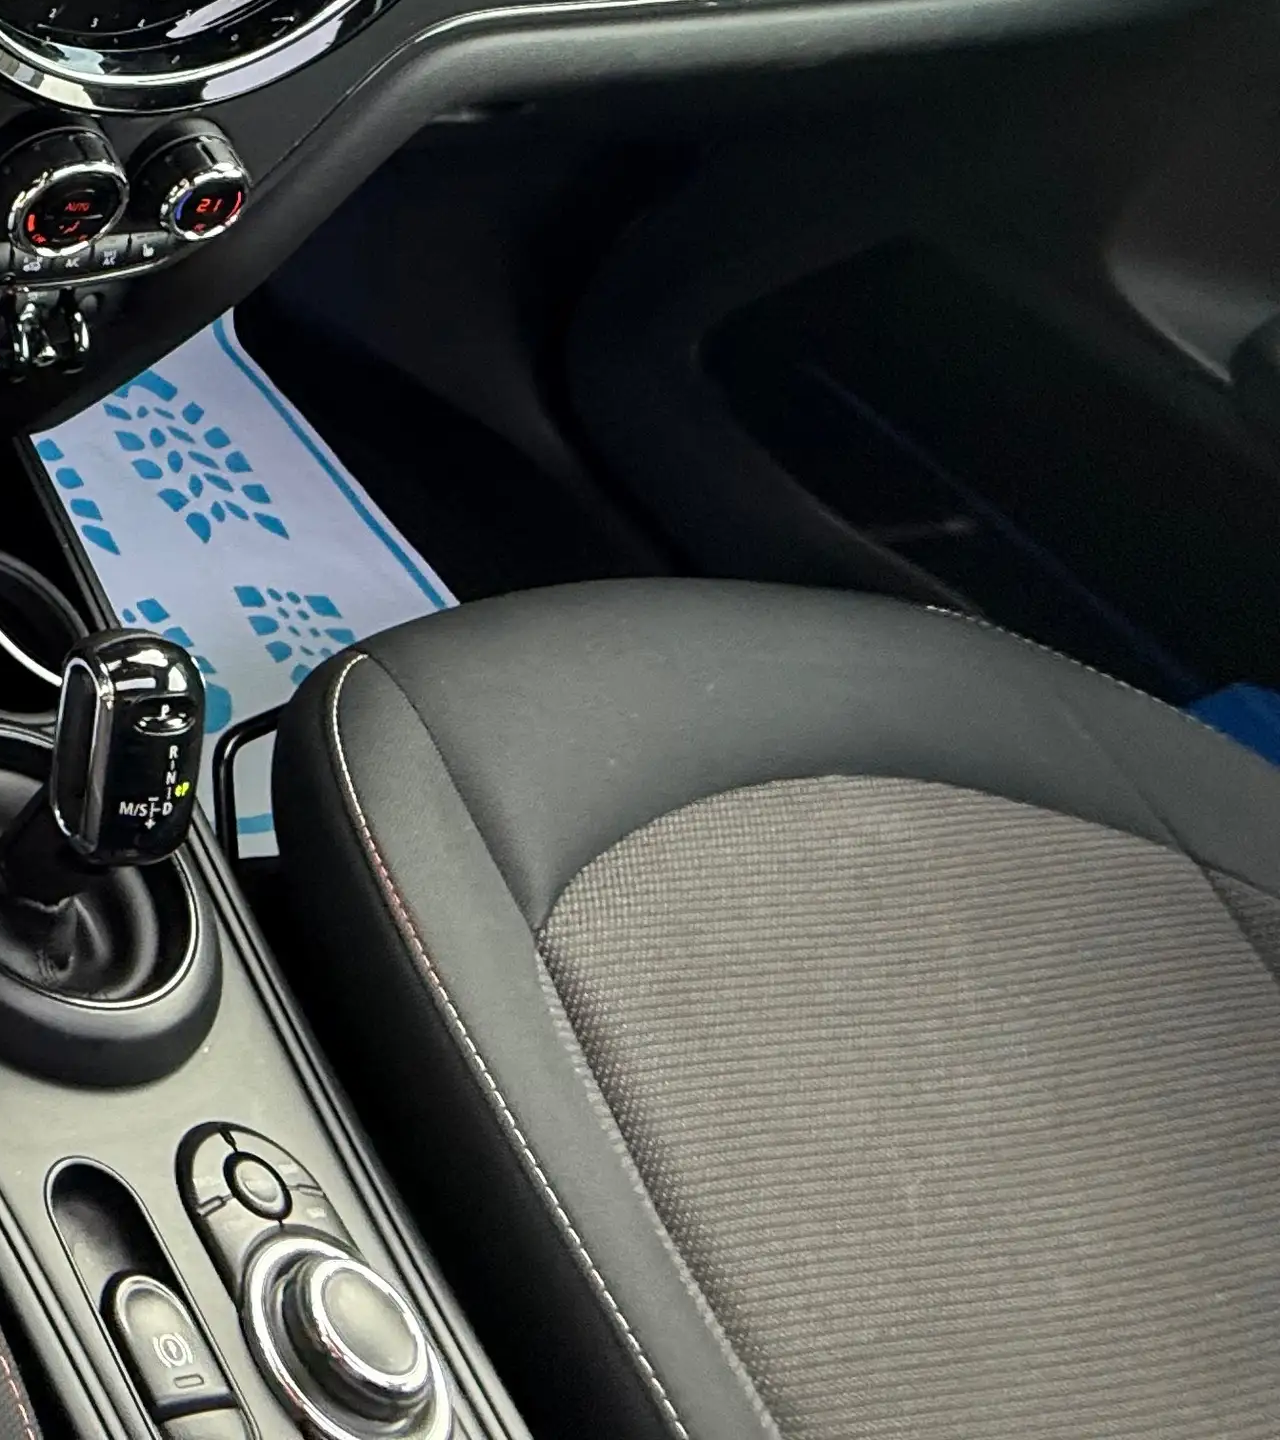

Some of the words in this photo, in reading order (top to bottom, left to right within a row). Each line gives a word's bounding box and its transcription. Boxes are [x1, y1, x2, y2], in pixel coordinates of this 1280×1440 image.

[64, 202, 90, 212] AUTO
[195, 199, 222, 213] 21
[119, 801, 148, 817] M/S
